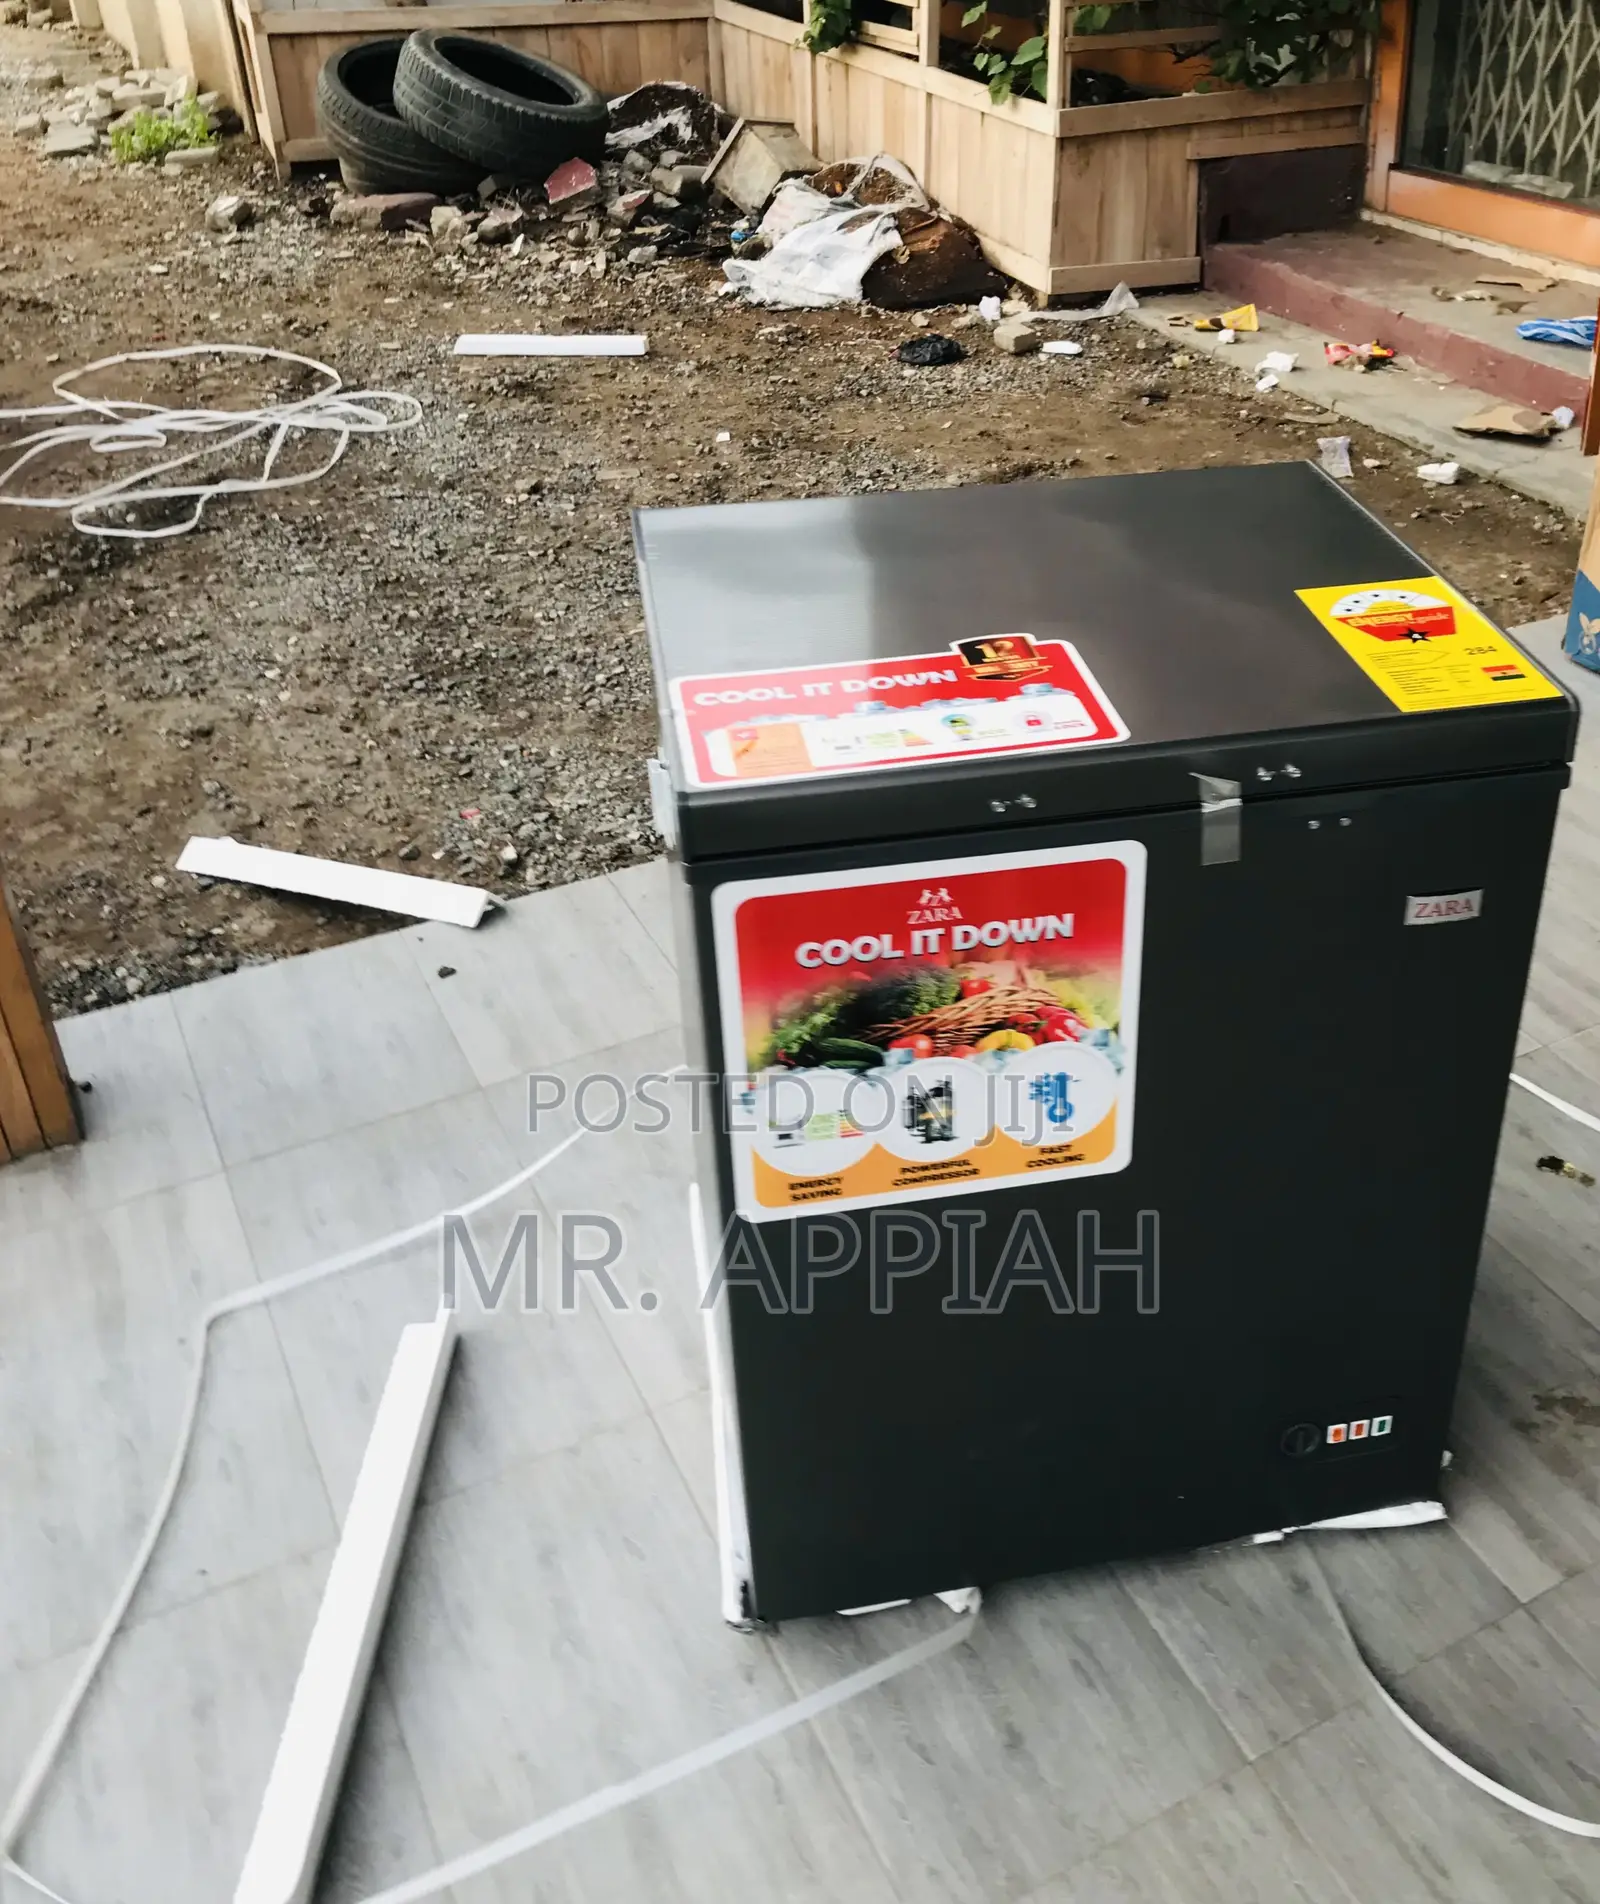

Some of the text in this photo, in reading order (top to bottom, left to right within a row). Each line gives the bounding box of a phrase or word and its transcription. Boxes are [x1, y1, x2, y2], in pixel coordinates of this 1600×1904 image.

[1464, 646, 1498, 656] 284
[693, 669, 958, 706] COOL IT DOWN
[906, 906, 964, 925] ZARA
[1414, 898, 1474, 918] ZARA
[795, 912, 1075, 969] COOL IT DOWN
[1038, 1144, 1073, 1155] FAST
[1025, 1153, 1086, 1169] COOLING
[788, 1176, 844, 1191] ENERGY
[892, 1168, 981, 1186] COMPRESSOR
